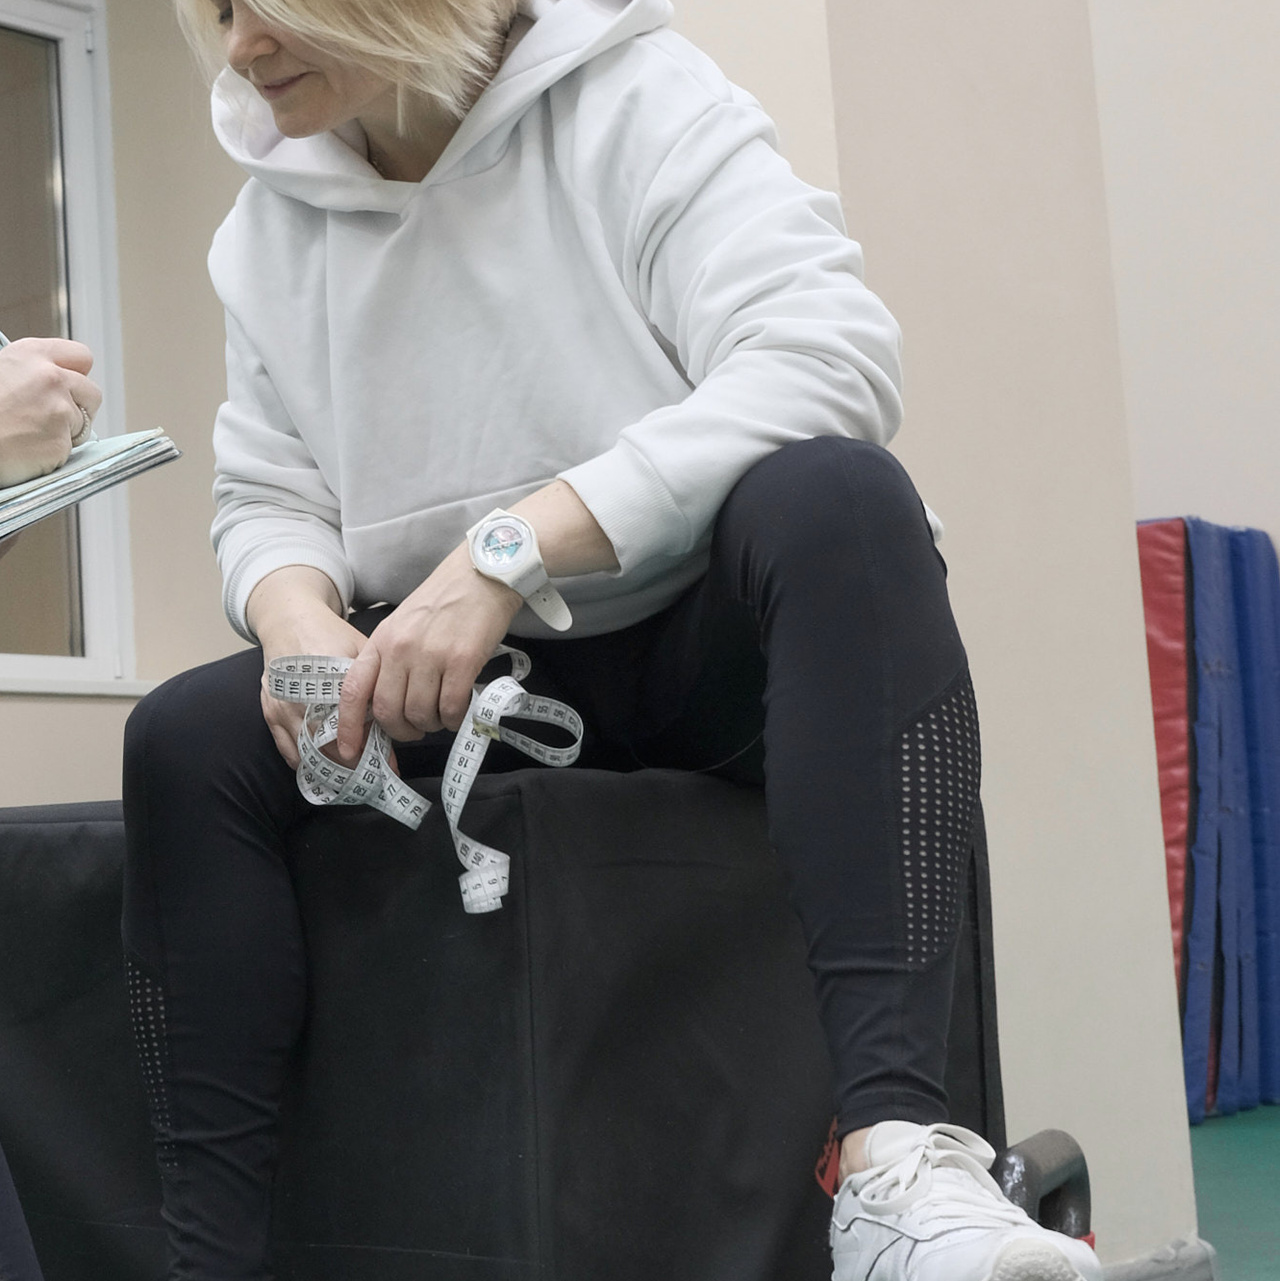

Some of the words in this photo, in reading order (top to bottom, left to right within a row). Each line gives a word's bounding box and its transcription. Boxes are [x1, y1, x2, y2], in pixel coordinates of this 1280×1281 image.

[275, 678, 284, 693] 115
[289, 681, 300, 695] 116
[306, 682, 316, 696] 117
[322, 682, 332, 696] 118
[480, 707, 494, 720] 149
[464, 741, 476, 753] 19
[458, 757, 469, 769] 18
[362, 772, 376, 785] 131
[452, 773, 463, 784] 17
[353, 786, 368, 797] 130
[387, 784, 397, 797] 77
[448, 788, 457, 800] 16
[397, 796, 410, 808] 78
[410, 806, 422, 818] 79
